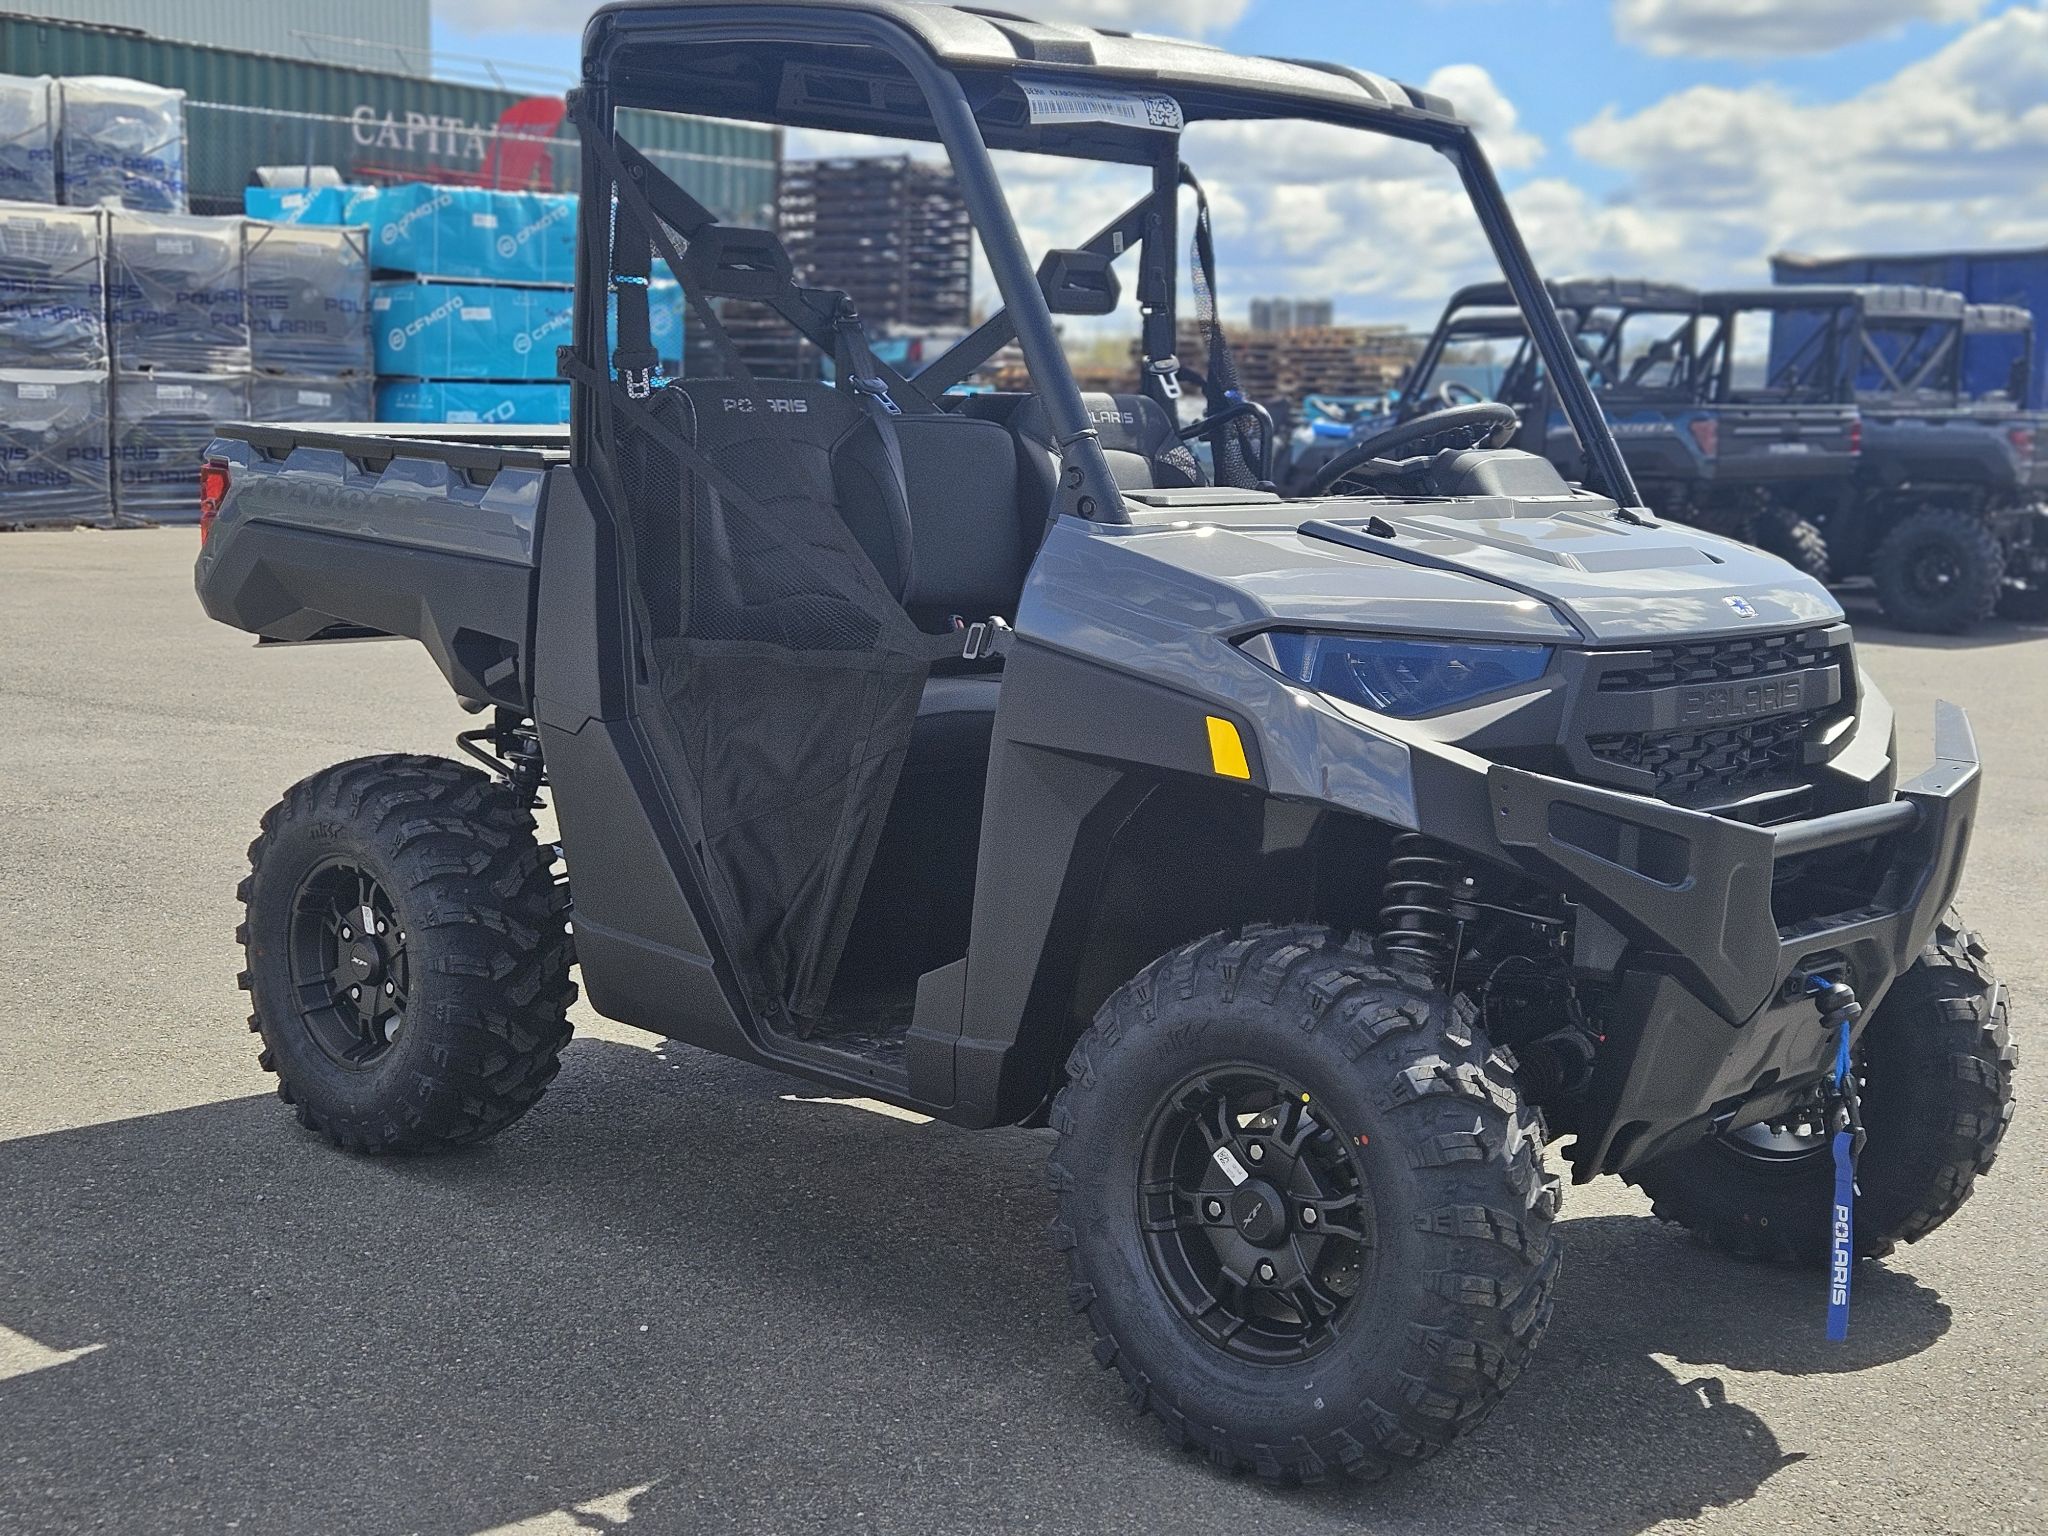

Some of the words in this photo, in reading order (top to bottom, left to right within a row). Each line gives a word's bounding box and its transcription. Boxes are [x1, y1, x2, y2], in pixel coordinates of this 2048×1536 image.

[404, 296, 464, 337] CFMOTO
[1682, 679, 1800, 721] POLARIS
[1832, 1204, 1849, 1306] POLARIS
